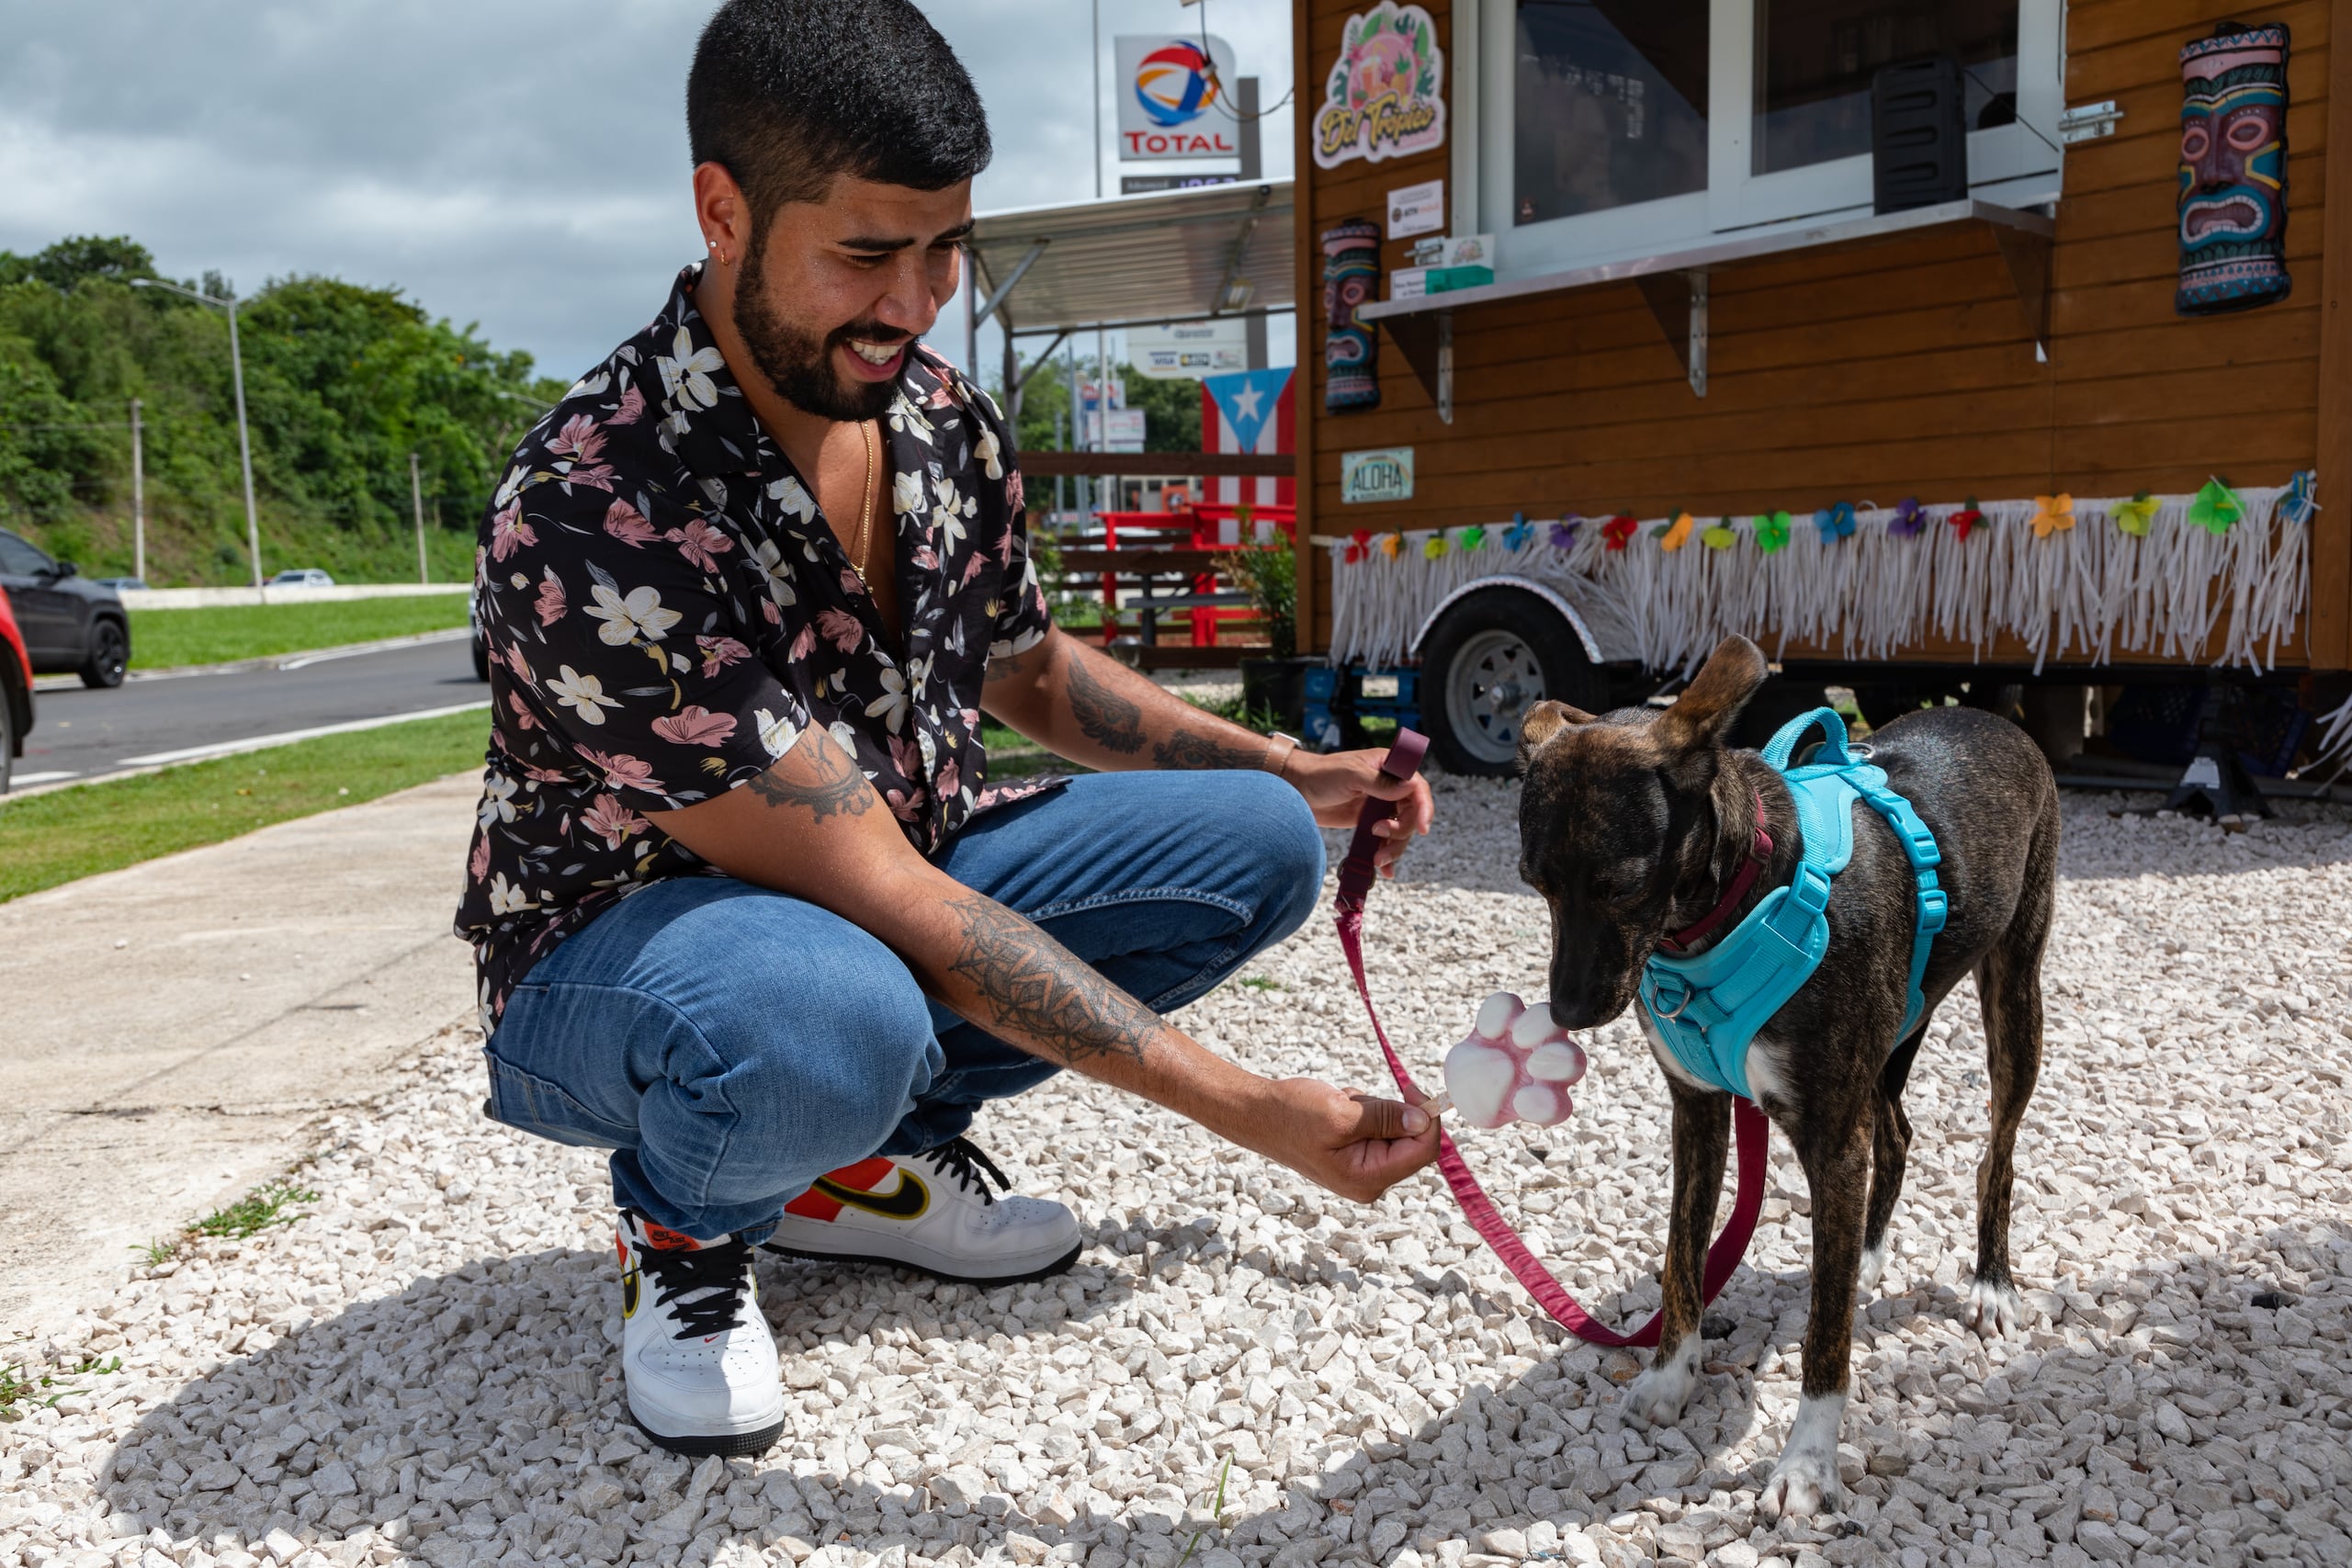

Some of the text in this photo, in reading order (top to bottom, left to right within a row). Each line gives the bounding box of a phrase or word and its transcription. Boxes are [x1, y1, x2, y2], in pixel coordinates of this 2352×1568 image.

[1124, 130, 1233, 154] TOTAL
[1321, 107, 1364, 154] Del
[1352, 462, 1402, 491] ALOHA
